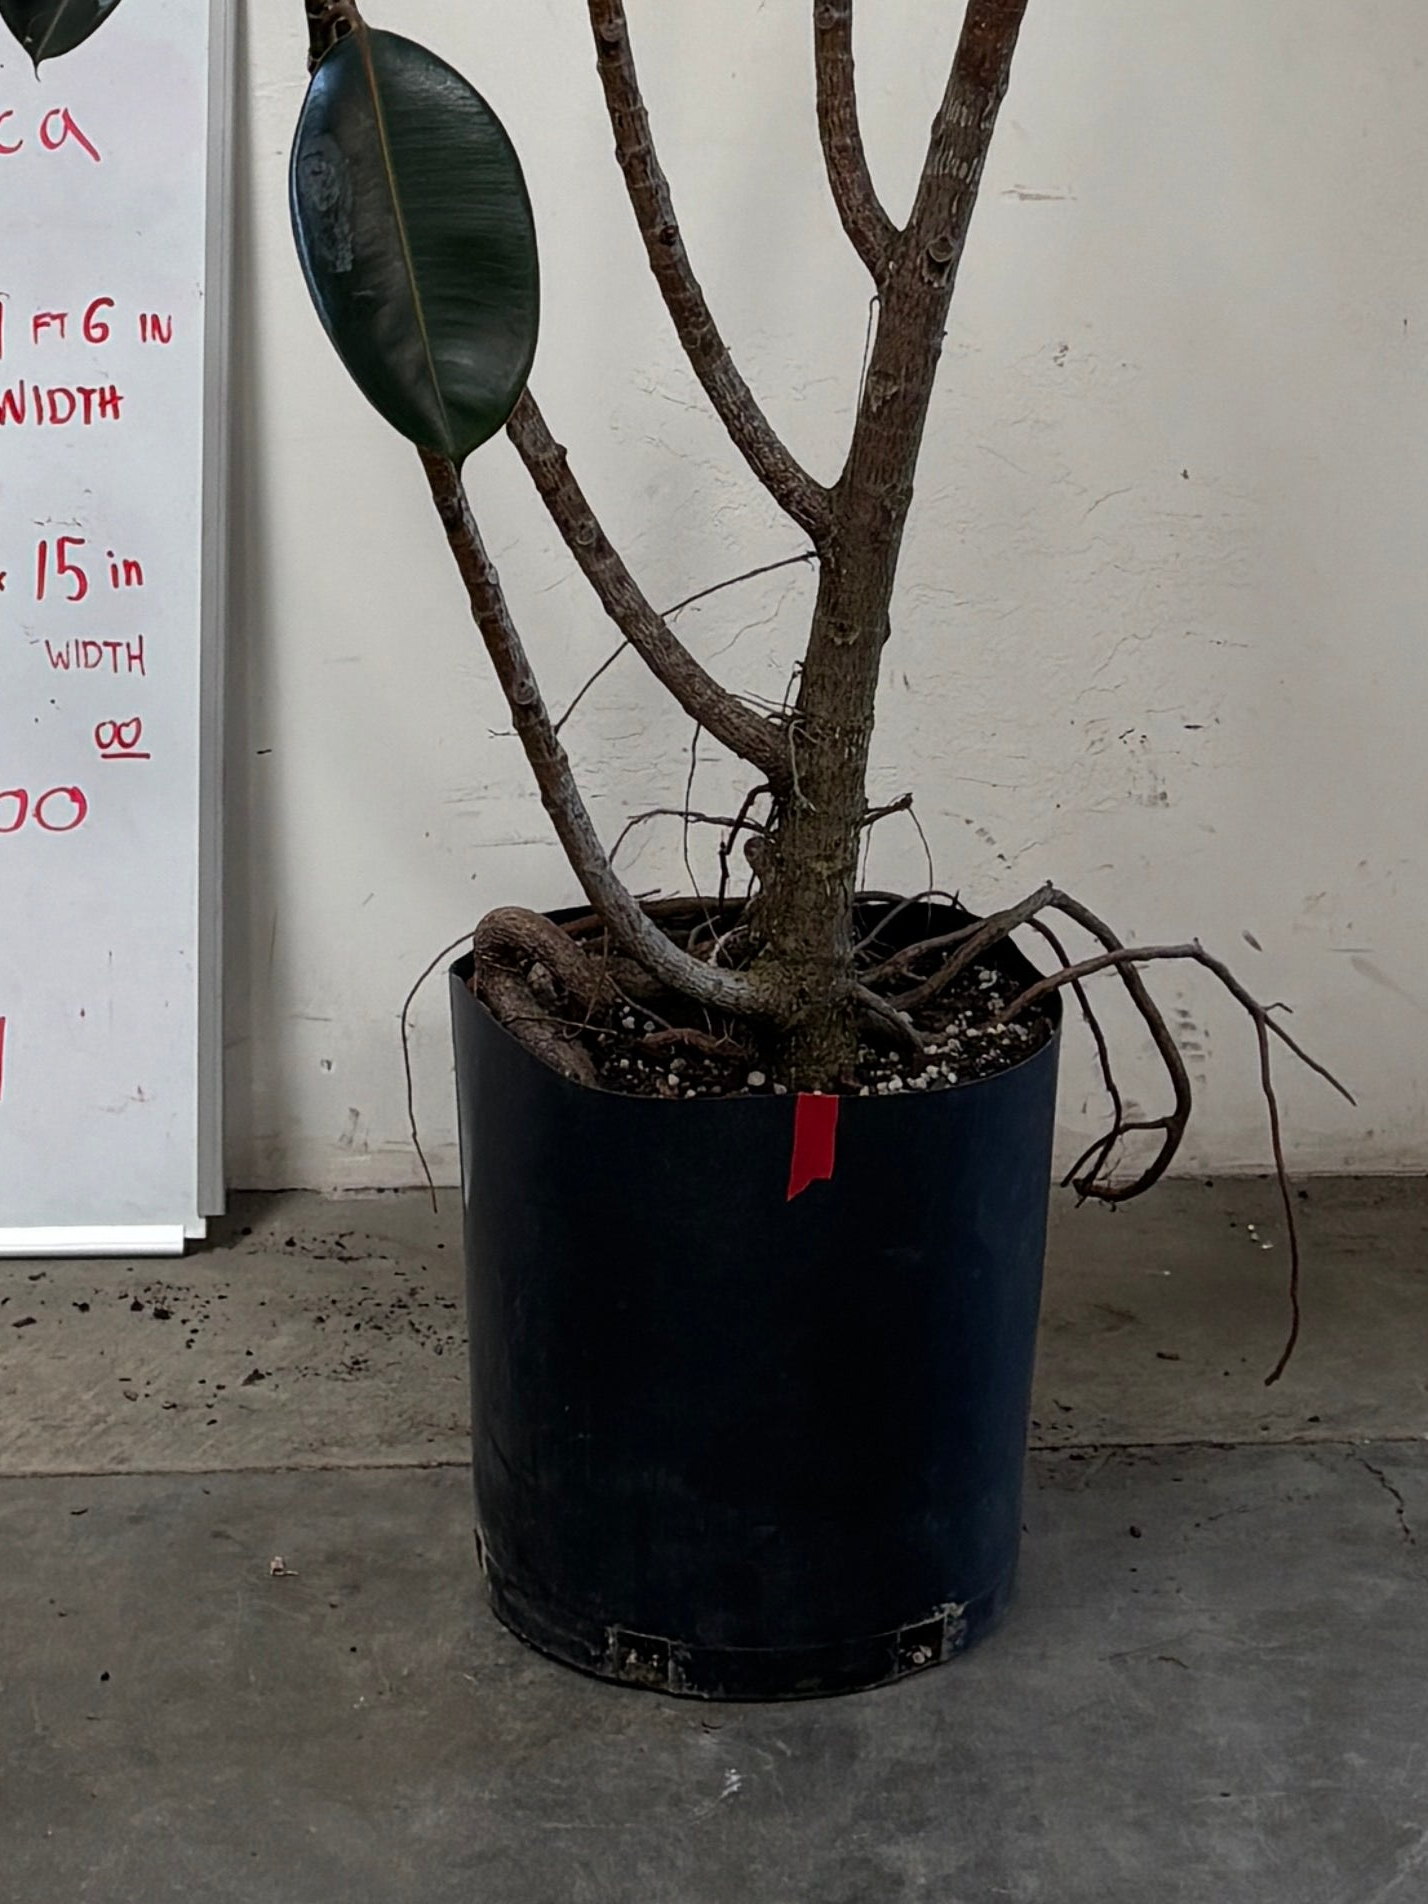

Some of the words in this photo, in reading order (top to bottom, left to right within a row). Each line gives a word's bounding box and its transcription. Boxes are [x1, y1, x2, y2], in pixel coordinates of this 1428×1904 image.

[30, 310, 68, 344] FT
[81, 297, 113, 345] 6
[138, 314, 172, 345] IN
[36, 536, 88, 603] 15
[108, 549, 145, 589] in
[45, 635, 147, 677] WIDTH
[94, 716, 145, 752] 00
